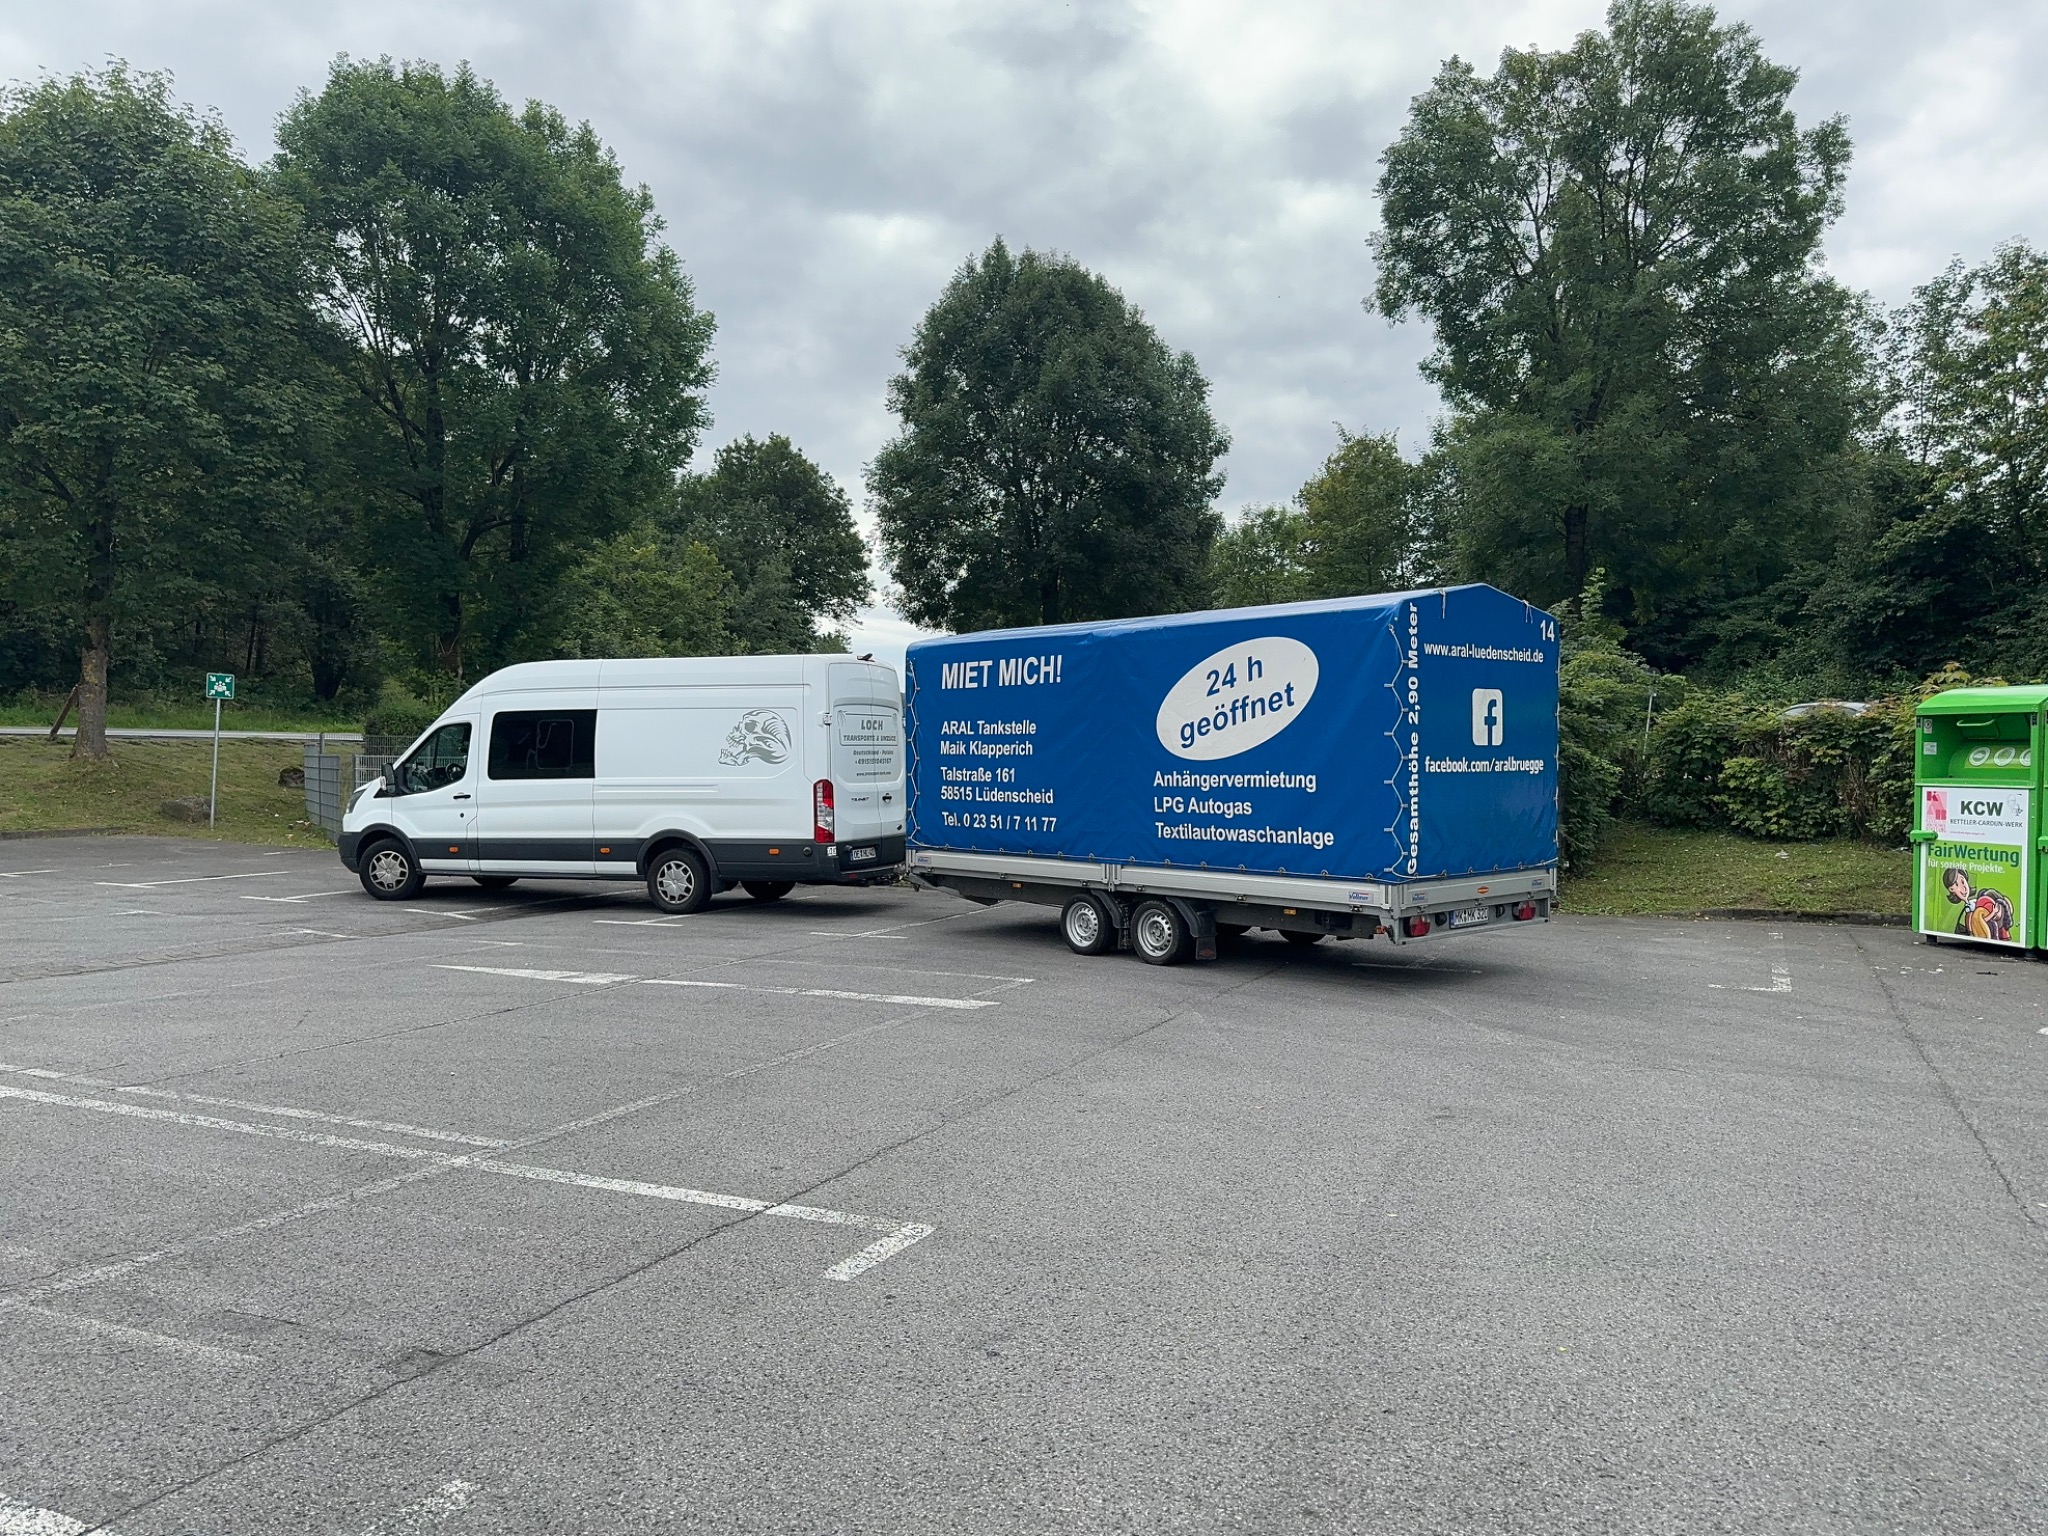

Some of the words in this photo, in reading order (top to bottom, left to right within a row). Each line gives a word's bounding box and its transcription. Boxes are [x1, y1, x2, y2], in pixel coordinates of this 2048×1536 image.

[1408, 602, 1418, 669] Meter
[1540, 619, 1555, 642] 14
[1423, 643, 1544, 663] www.aral-luedenscheid.de
[941, 659, 993, 690] MIET
[998, 654, 1063, 687] MICH!
[1205, 662, 1237, 697] 24
[1246, 655, 1263, 682] h
[1407, 676, 1421, 725] 2,90
[860, 719, 884, 731] LOCH
[1180, 681, 1295, 748] geöffnet
[941, 720, 975, 735] ARAL
[976, 719, 1037, 735] Tankstelle
[940, 740, 967, 756] Maik
[969, 740, 1033, 759] Klapperich
[941, 766, 992, 783] Talstraße
[995, 768, 1015, 783] 161
[1424, 756, 1544, 775] facebook.com/aralbruegge
[1153, 770, 1317, 792] Anhängervermietung
[941, 785, 973, 801] 58515
[975, 786, 1054, 804] Lüdenscheid
[1407, 731, 1419, 875] Gesamthöhe
[1154, 796, 1185, 814] LPG
[1187, 797, 1253, 818] Autogas
[1960, 800, 2004, 816] KCW
[942, 811, 961, 827] Tel.
[963, 813, 971, 828] 0
[973, 813, 987, 829] 23
[989, 814, 1003, 830] 51
[1013, 815, 1021, 830] 7
[1024, 816, 1037, 831] 11
[1041, 816, 1057, 832] 77
[1154, 821, 1335, 849] Textilautowaschanlage
[1927, 857, 1939, 868] für
[1940, 860, 1967, 871] soziale
[1969, 861, 2006, 874] Projekte.
[1928, 842, 2020, 868] FairWertung
